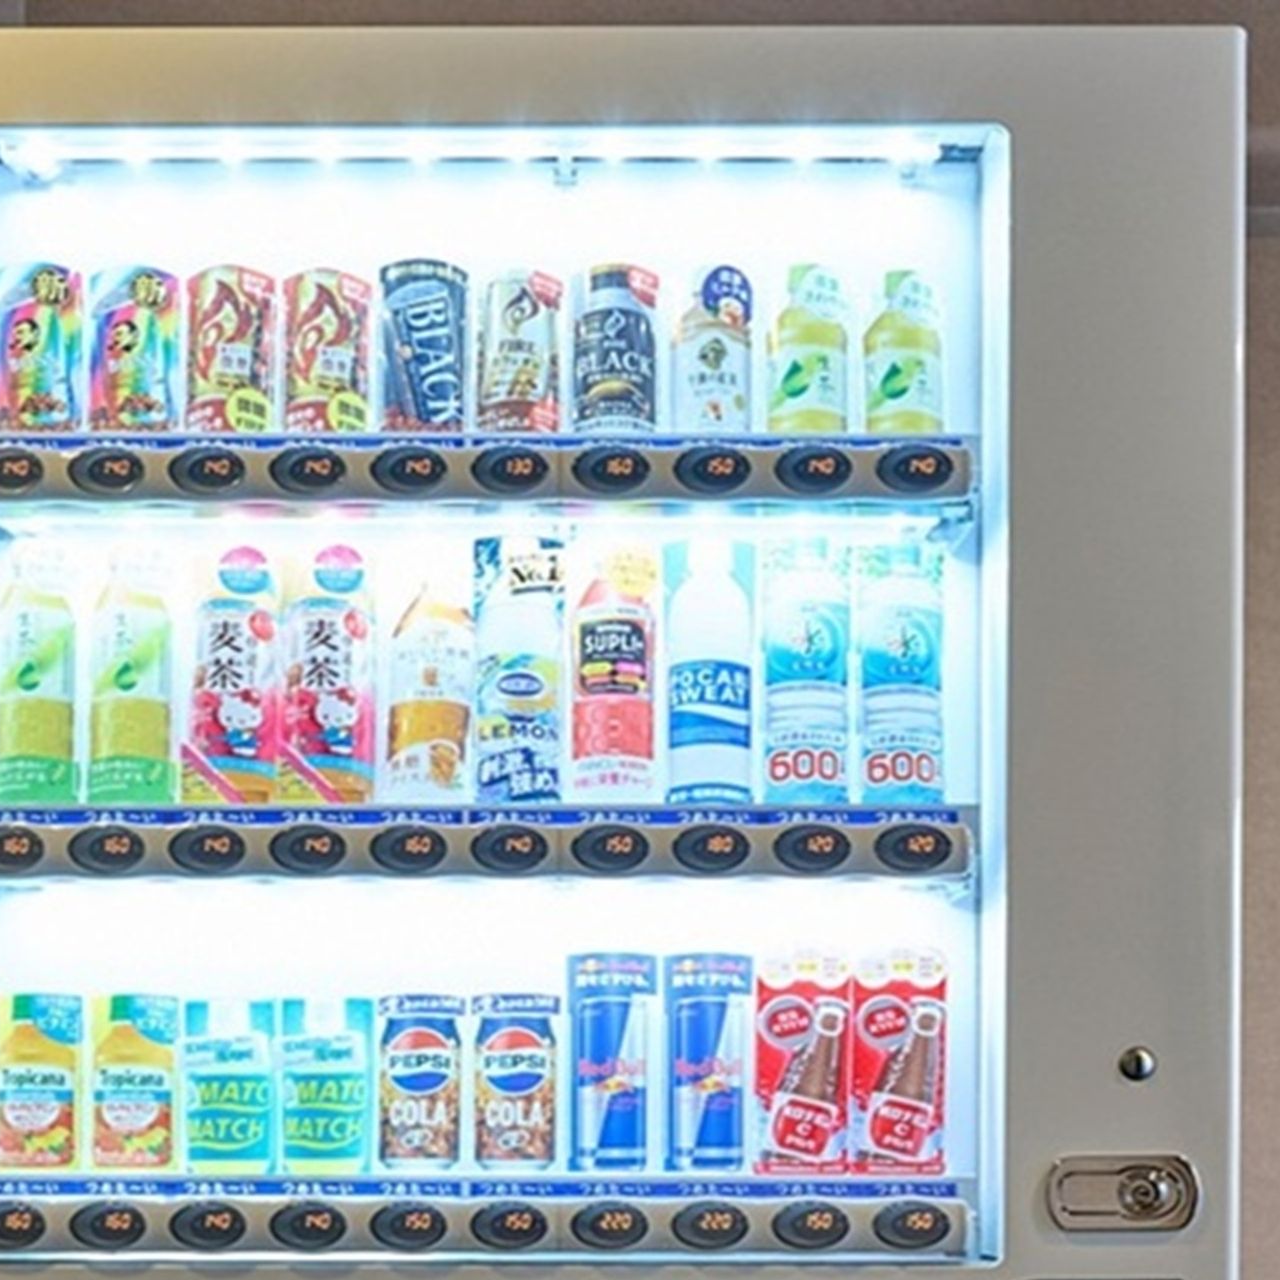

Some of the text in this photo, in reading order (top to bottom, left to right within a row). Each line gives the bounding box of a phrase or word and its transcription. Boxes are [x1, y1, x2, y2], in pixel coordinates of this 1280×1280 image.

[405, 300, 464, 424] BLACK
[576, 351, 653, 379] BLACK
[209, 620, 243, 689] 麦茶
[304, 619, 340, 688] 麦茶
[769, 749, 839, 782] 600
[867, 751, 936, 784] 600
[390, 1053, 451, 1069] PEPSI
[484, 1053, 546, 1069] PEPSI
[1, 1068, 66, 1089] Tropicana
[99, 1068, 165, 1089] Tropicana
[389, 1099, 447, 1127] COLA
[485, 1099, 544, 1127] COLA
